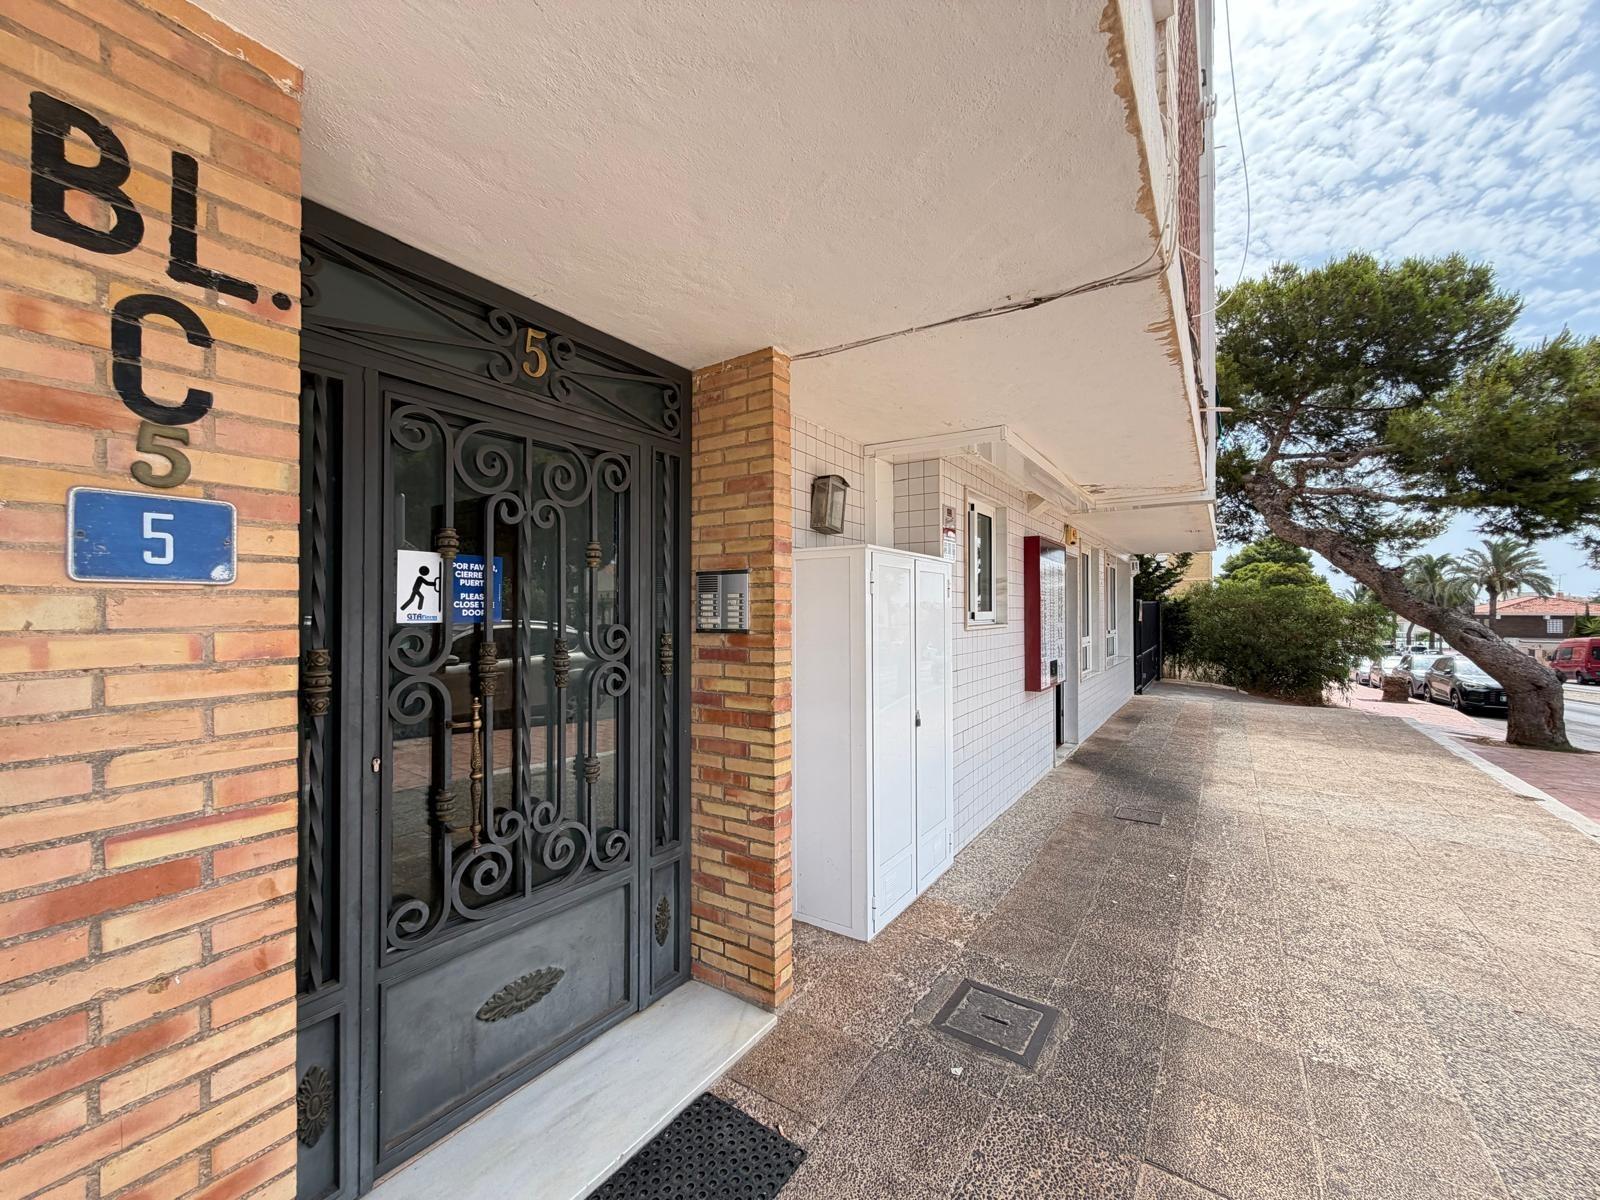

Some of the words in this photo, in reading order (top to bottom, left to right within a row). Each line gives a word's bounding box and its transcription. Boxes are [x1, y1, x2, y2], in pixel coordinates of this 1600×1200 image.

[111, 294, 214, 426] C
[523, 328, 547, 378] 5
[130, 421, 192, 488] 5
[142, 512, 174, 565] 5
[455, 571, 483, 579] CIERRE
[460, 579, 485, 587] PUERT
[470, 563, 498, 573] FAVR,
[460, 592, 485, 600] PLEAS
